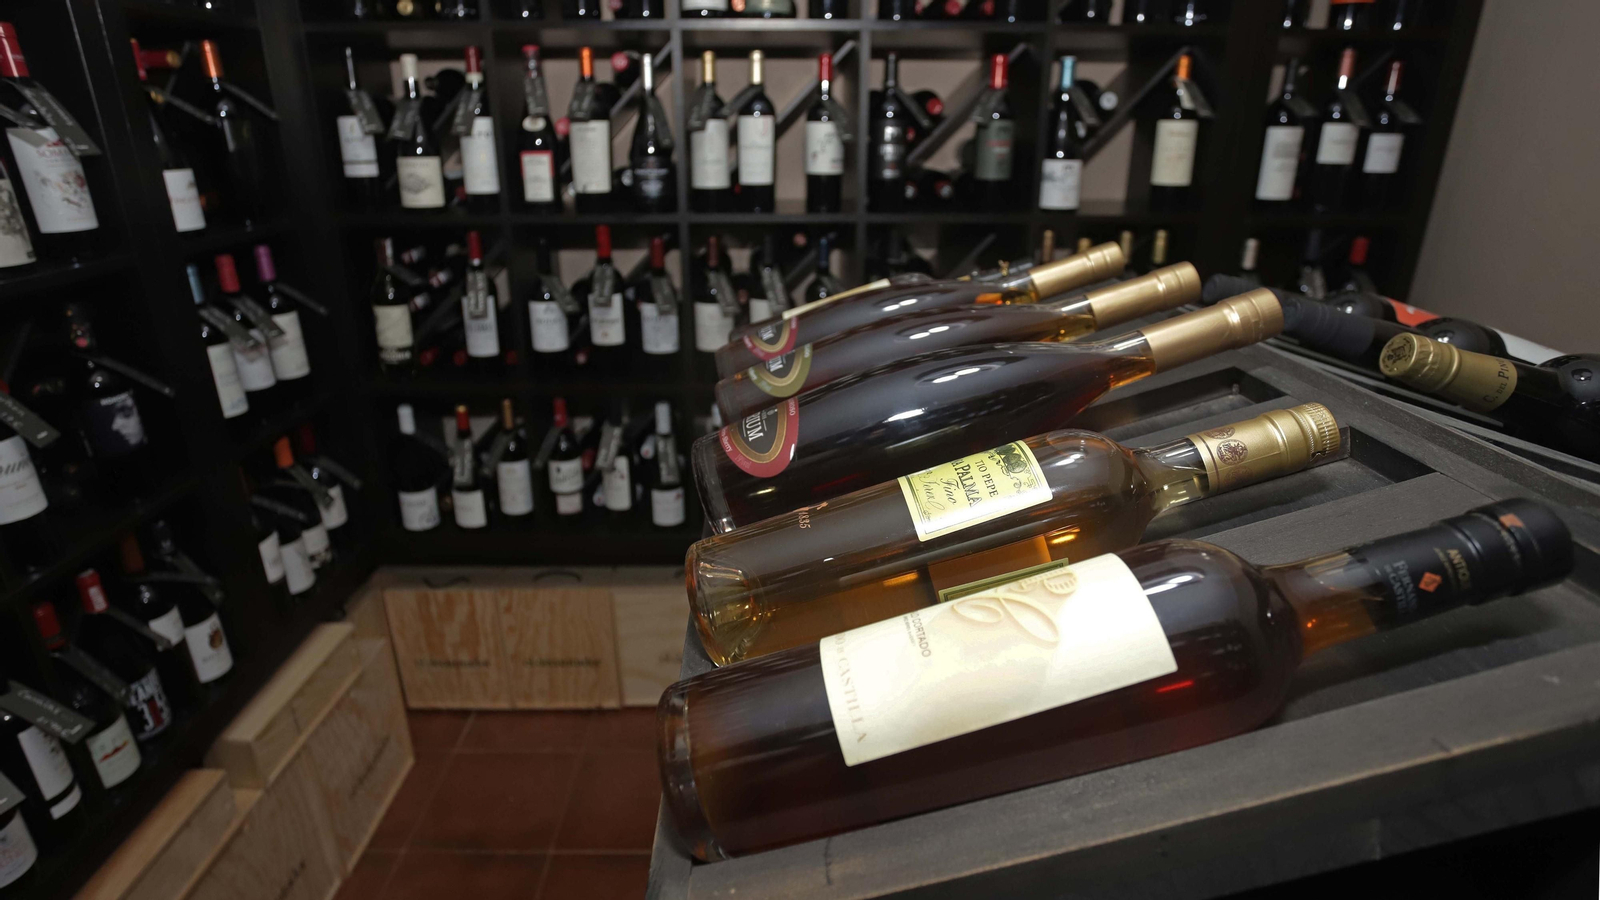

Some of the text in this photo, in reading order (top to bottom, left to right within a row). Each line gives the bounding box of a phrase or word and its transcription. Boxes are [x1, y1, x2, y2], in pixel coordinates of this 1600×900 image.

[939, 477, 961, 505] Fino
[954, 463, 983, 508] PALMA
[974, 459, 999, 498] TIO PEPE
[798, 511, 812, 529] 1835
[911, 618, 932, 658] CORTADO
[838, 656, 868, 744] CASTILLA
